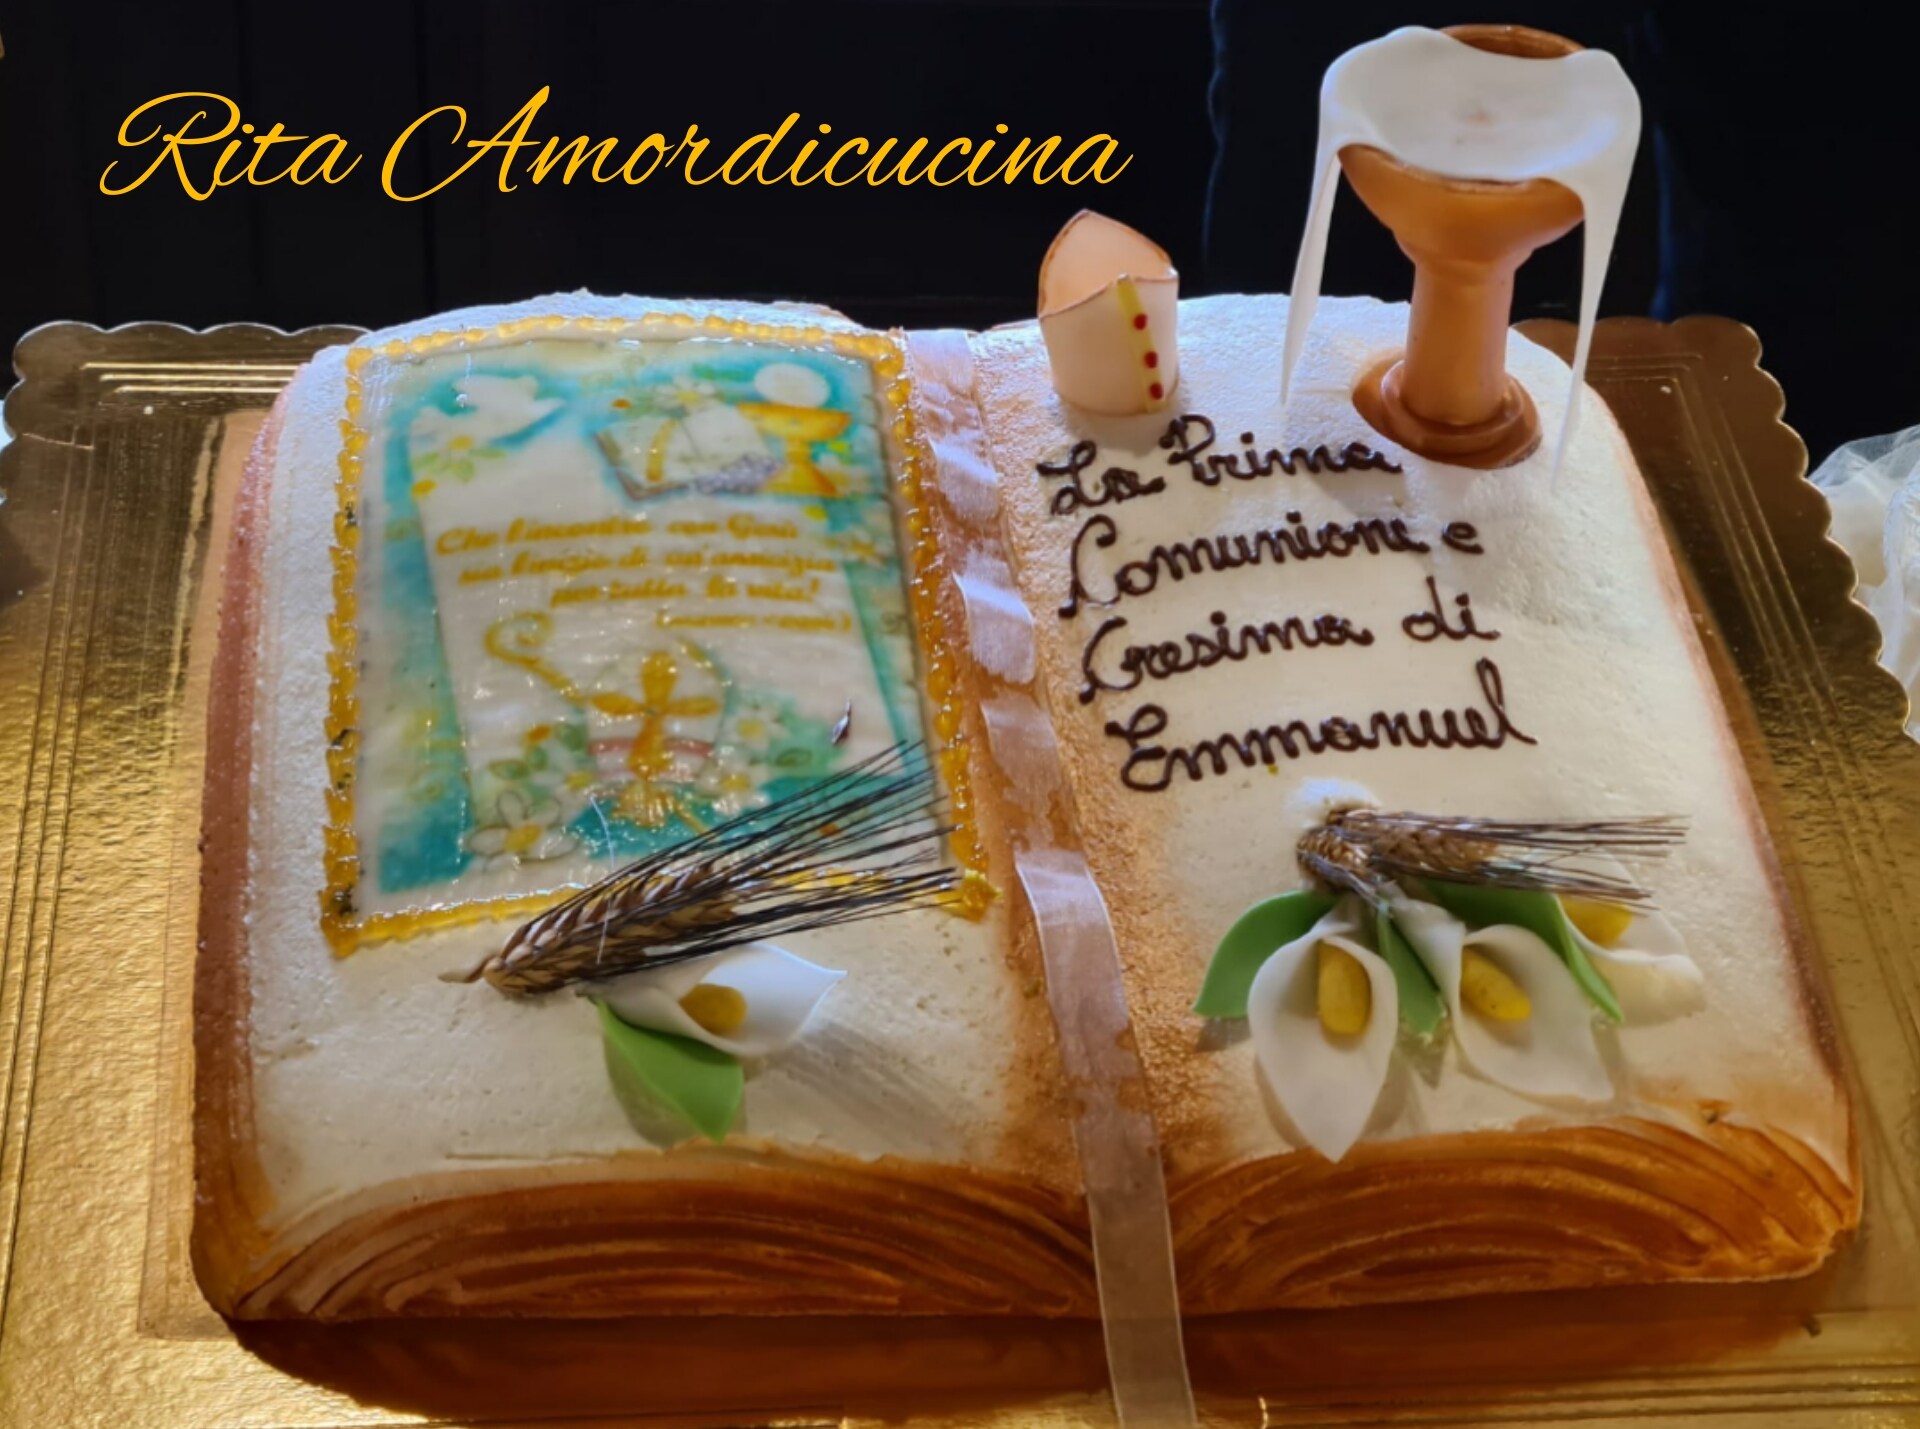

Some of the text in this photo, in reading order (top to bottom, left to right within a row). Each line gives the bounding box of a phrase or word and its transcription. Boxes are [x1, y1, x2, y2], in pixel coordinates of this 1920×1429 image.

[1036, 413, 1402, 517] La Prima
[1057, 511, 1484, 619] Comunione e
[1079, 575, 1501, 704] Cresima di
[1105, 656, 1538, 792] Emmanuel
